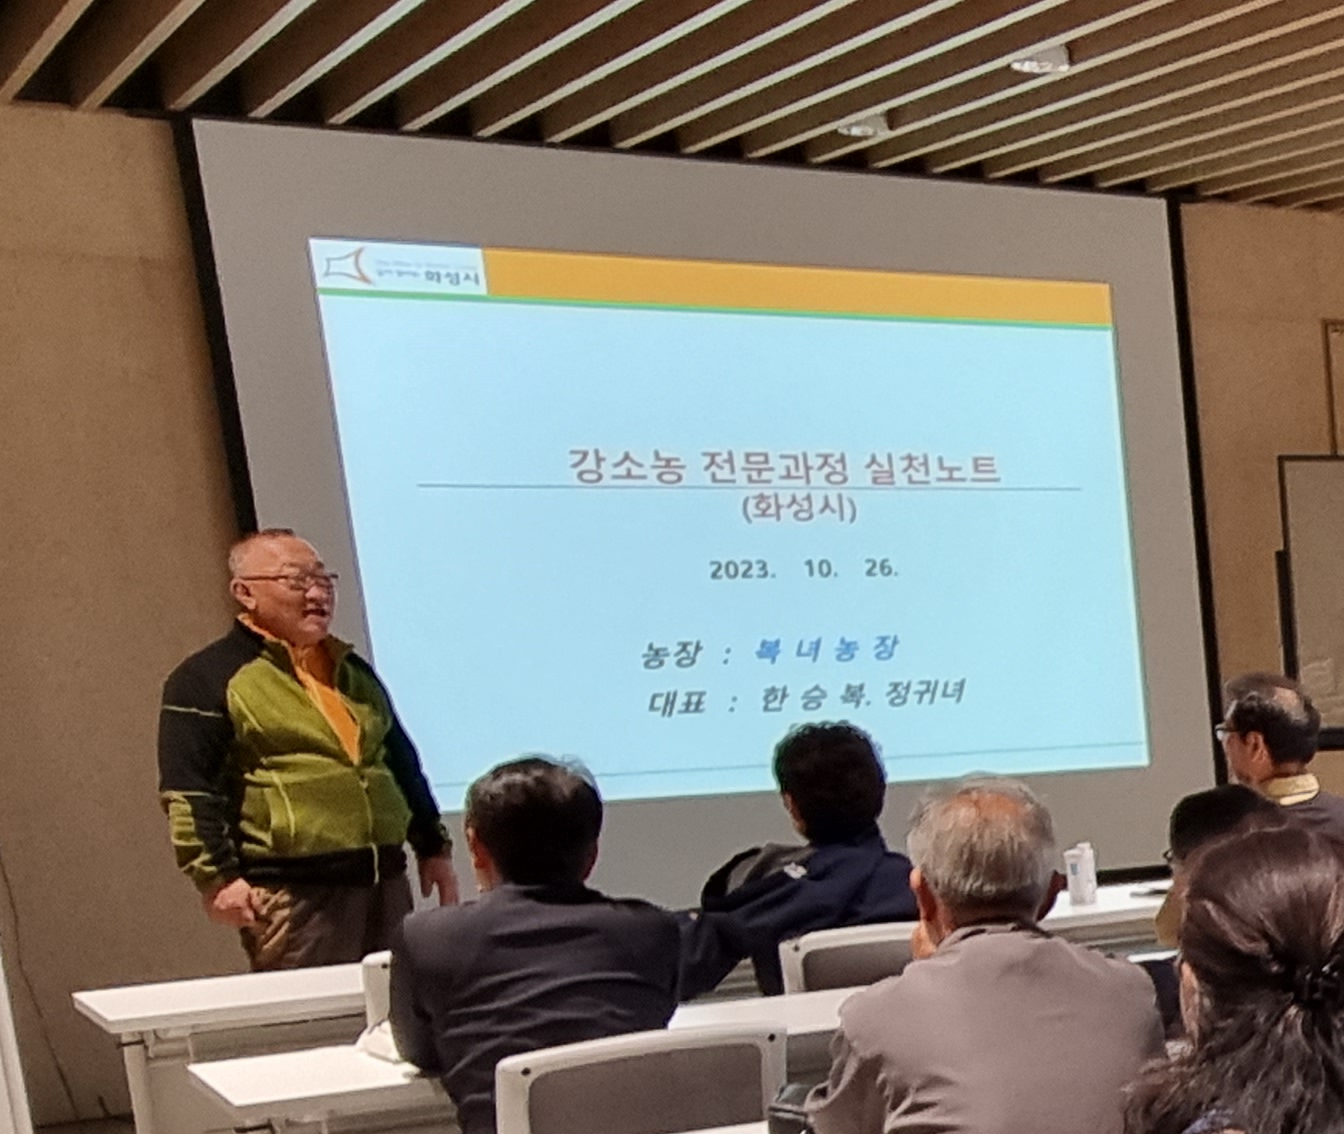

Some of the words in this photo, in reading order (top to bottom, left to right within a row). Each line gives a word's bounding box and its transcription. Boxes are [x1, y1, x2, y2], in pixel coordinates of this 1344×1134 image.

[424, 270, 480, 286] 화성시
[569, 448, 686, 485] 강소농
[701, 449, 849, 486] 전문과정
[864, 452, 1001, 486] 실천노트
[742, 492, 857, 524] (화성시)
[709, 559, 776, 580] 2023.
[804, 558, 838, 578] 10.
[864, 558, 899, 577] 26.
[641, 640, 704, 670] 농장
[648, 689, 708, 718] 대표
[886, 677, 967, 708] 정귀녀
